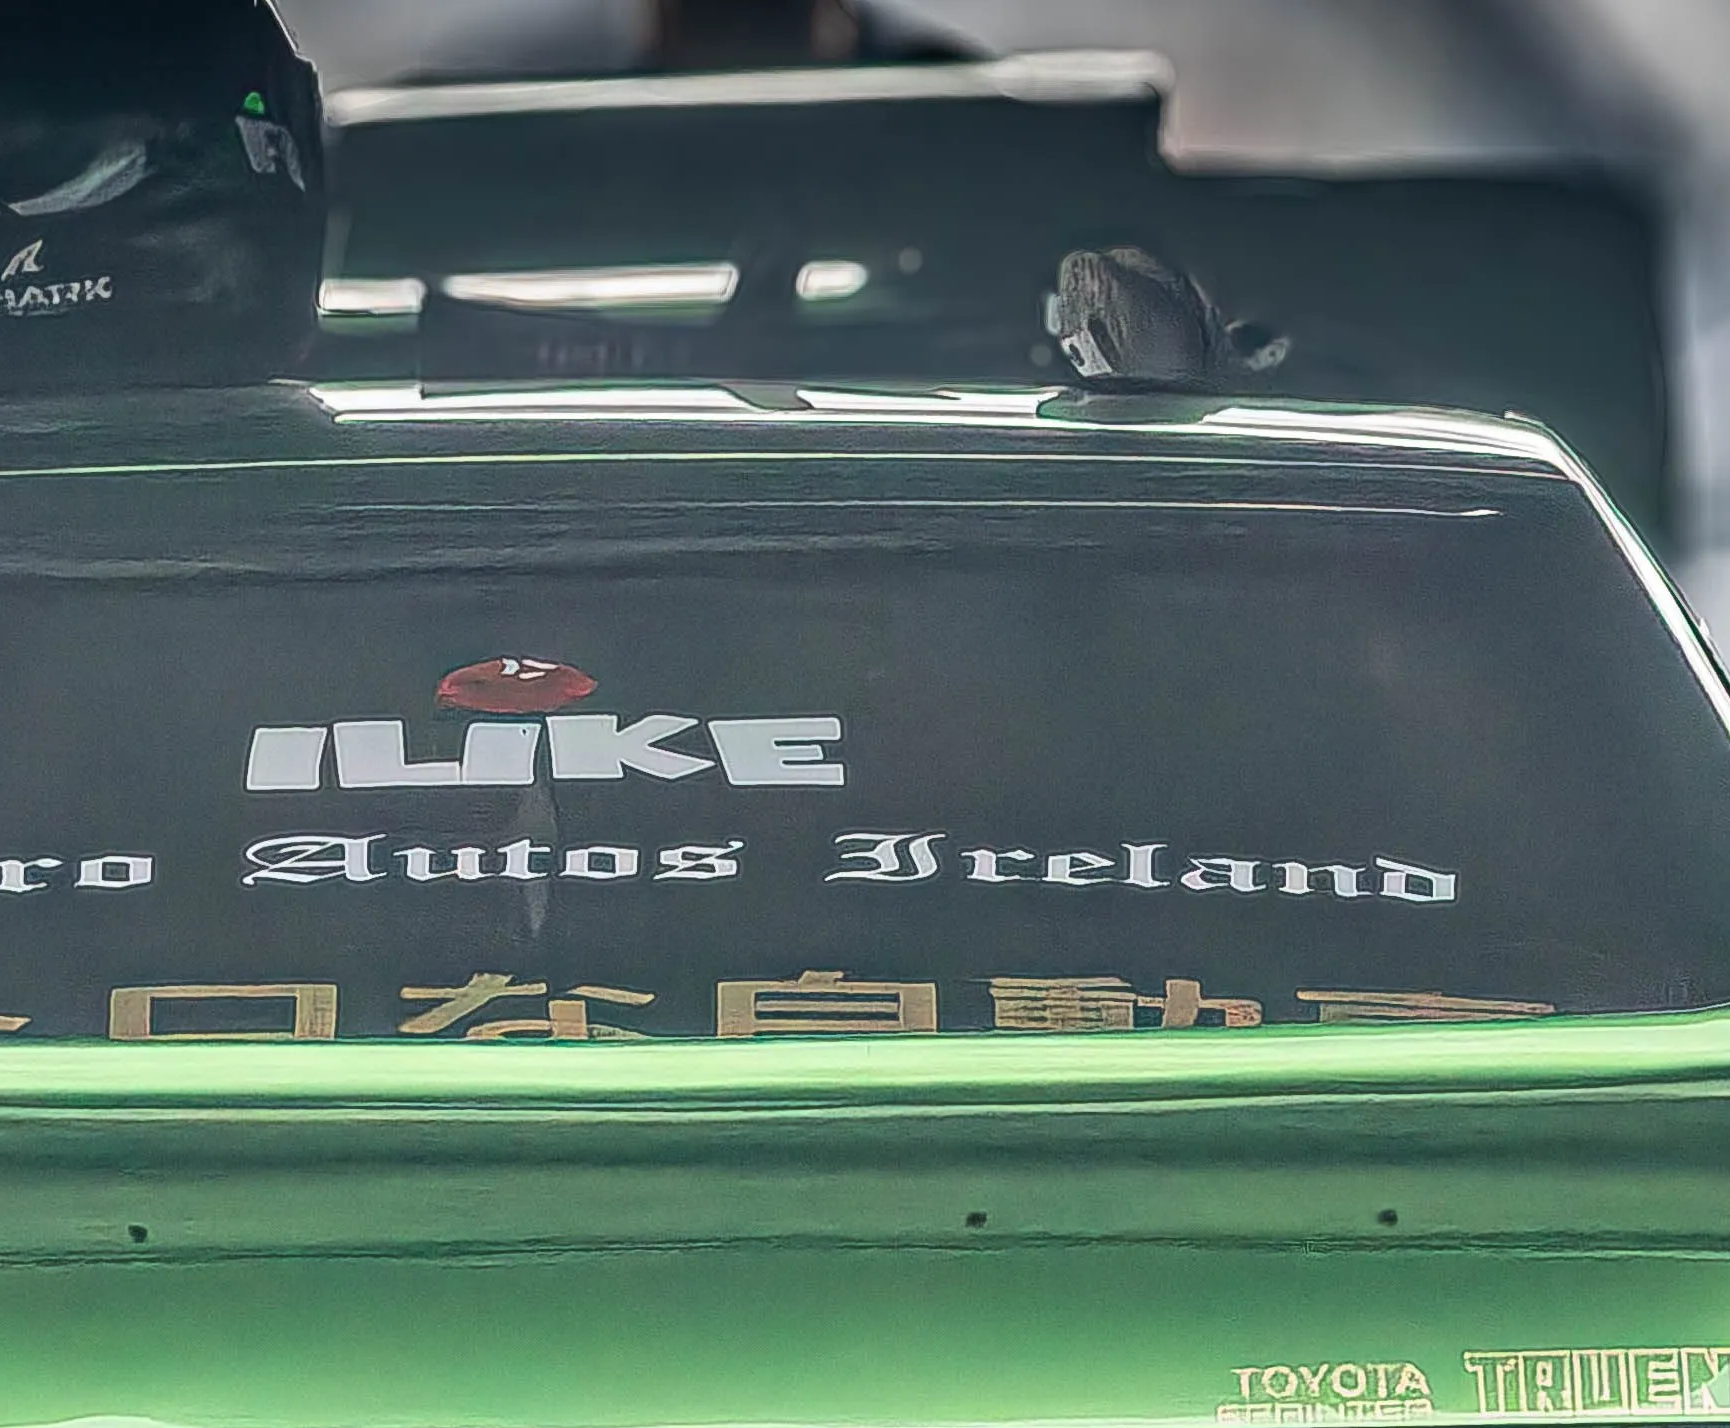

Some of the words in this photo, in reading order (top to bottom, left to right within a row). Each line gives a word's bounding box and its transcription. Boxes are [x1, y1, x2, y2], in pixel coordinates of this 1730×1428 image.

[241, 832, 744, 886] Autos
[824, 832, 1457, 903] Ireland
[1230, 1363, 1432, 1398] TOYOTA
